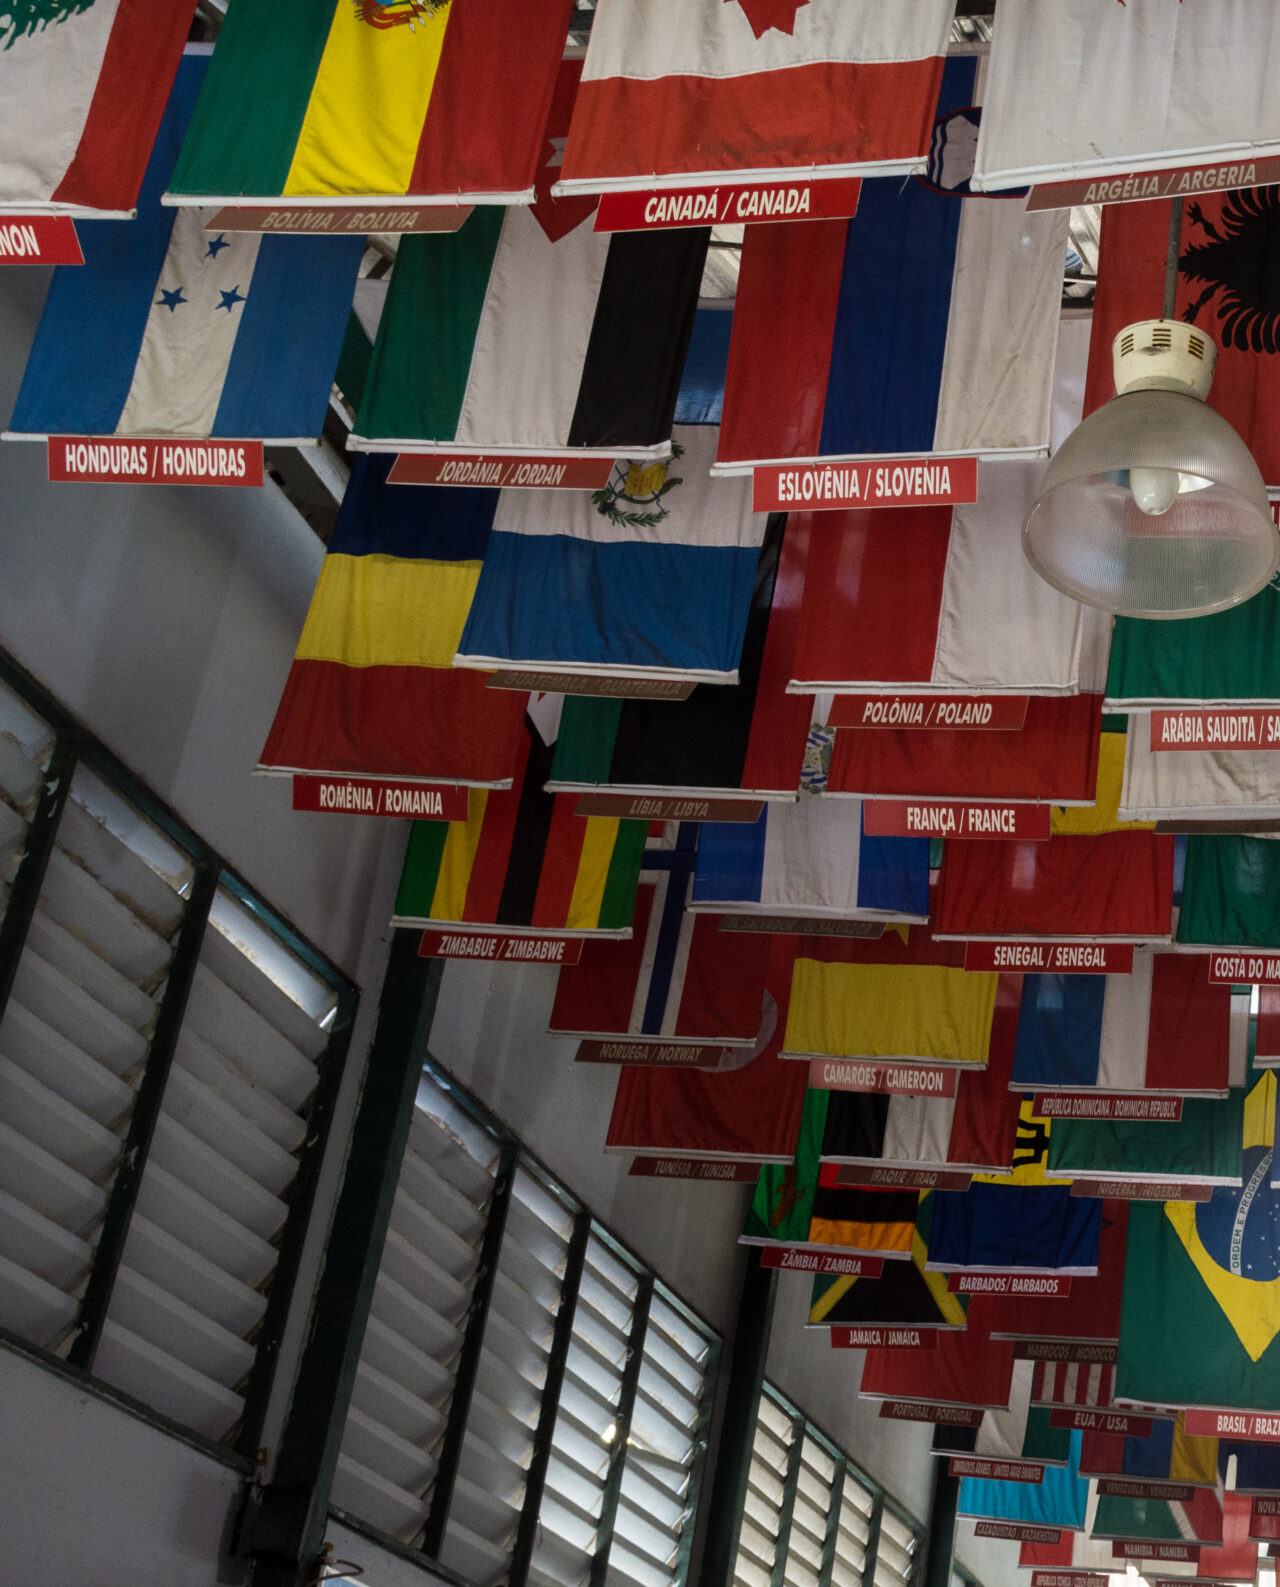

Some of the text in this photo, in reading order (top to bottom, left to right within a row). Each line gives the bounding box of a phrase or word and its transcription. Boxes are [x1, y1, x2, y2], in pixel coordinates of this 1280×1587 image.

[1083, 164, 1256, 202] ARGÉLIA ARGERIA
[261, 209, 419, 229] BOLÍVIA BOLIVIA
[644, 189, 810, 223] CANADÁ CANADA
[0, 225, 41, 256] NON
[66, 445, 245, 476] HONDURAS HONDURAS
[511, 464, 566, 485] JORDAN
[779, 466, 951, 501] ESLOVÊNIA SLOVENIA
[862, 698, 992, 724] POLÔNIA POLAND
[1162, 713, 1203, 742] ARÁBIA
[1207, 717, 1255, 742] SAUDITA
[320, 782, 442, 814] ROMÊNIA ROMANIA
[630, 798, 709, 816] LÍBIA LIBYA
[908, 807, 1015, 835] FRANÇA FRANCE
[437, 936, 565, 960] ZIMBABUE ZIMBABWE
[994, 946, 1106, 966] SENEGAL SENEGAL
[1215, 958, 1245, 977] COSTA
[1248, 959, 1263, 978] DO
[600, 1044, 703, 1061] NORUEGA NORWAY
[824, 1064, 943, 1090] CAMARÕES CAMEROON
[1232, 1229, 1242, 1269] ORDEM
[1074, 1413, 1127, 1431] EUA USA
[1217, 1415, 1246, 1433] BRASIL
